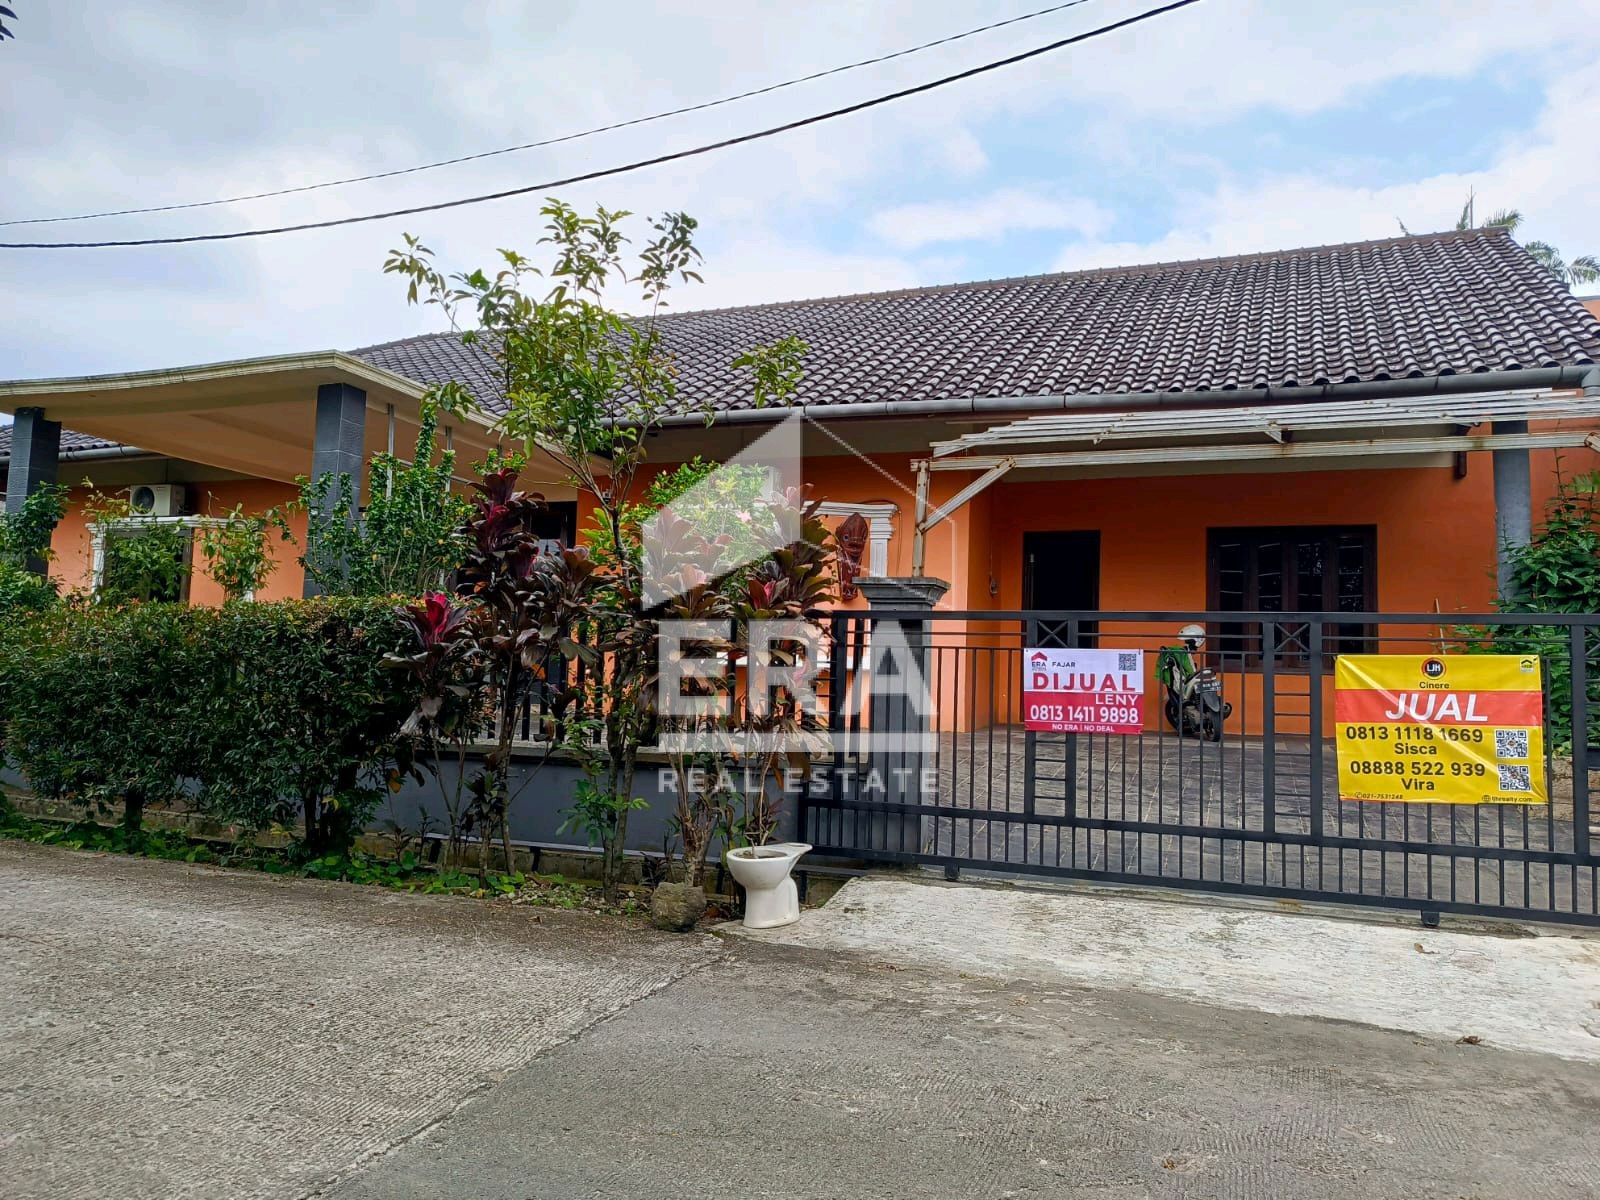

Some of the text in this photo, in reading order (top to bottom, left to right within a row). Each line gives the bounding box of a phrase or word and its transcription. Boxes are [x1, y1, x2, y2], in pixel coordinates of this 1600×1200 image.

[1033, 672, 1136, 692] DIJUAL
[1419, 681, 1450, 689] Cinere
[1095, 694, 1138, 706] LENY
[1385, 693, 1489, 722] JUAL
[1030, 705, 1139, 724] 0813 1411 9898
[1346, 726, 1484, 743] 0813 1118 1669
[1394, 742, 1438, 755] Sisca
[1350, 760, 1486, 777] 08888 522 939
[1401, 778, 1435, 791] Vira
